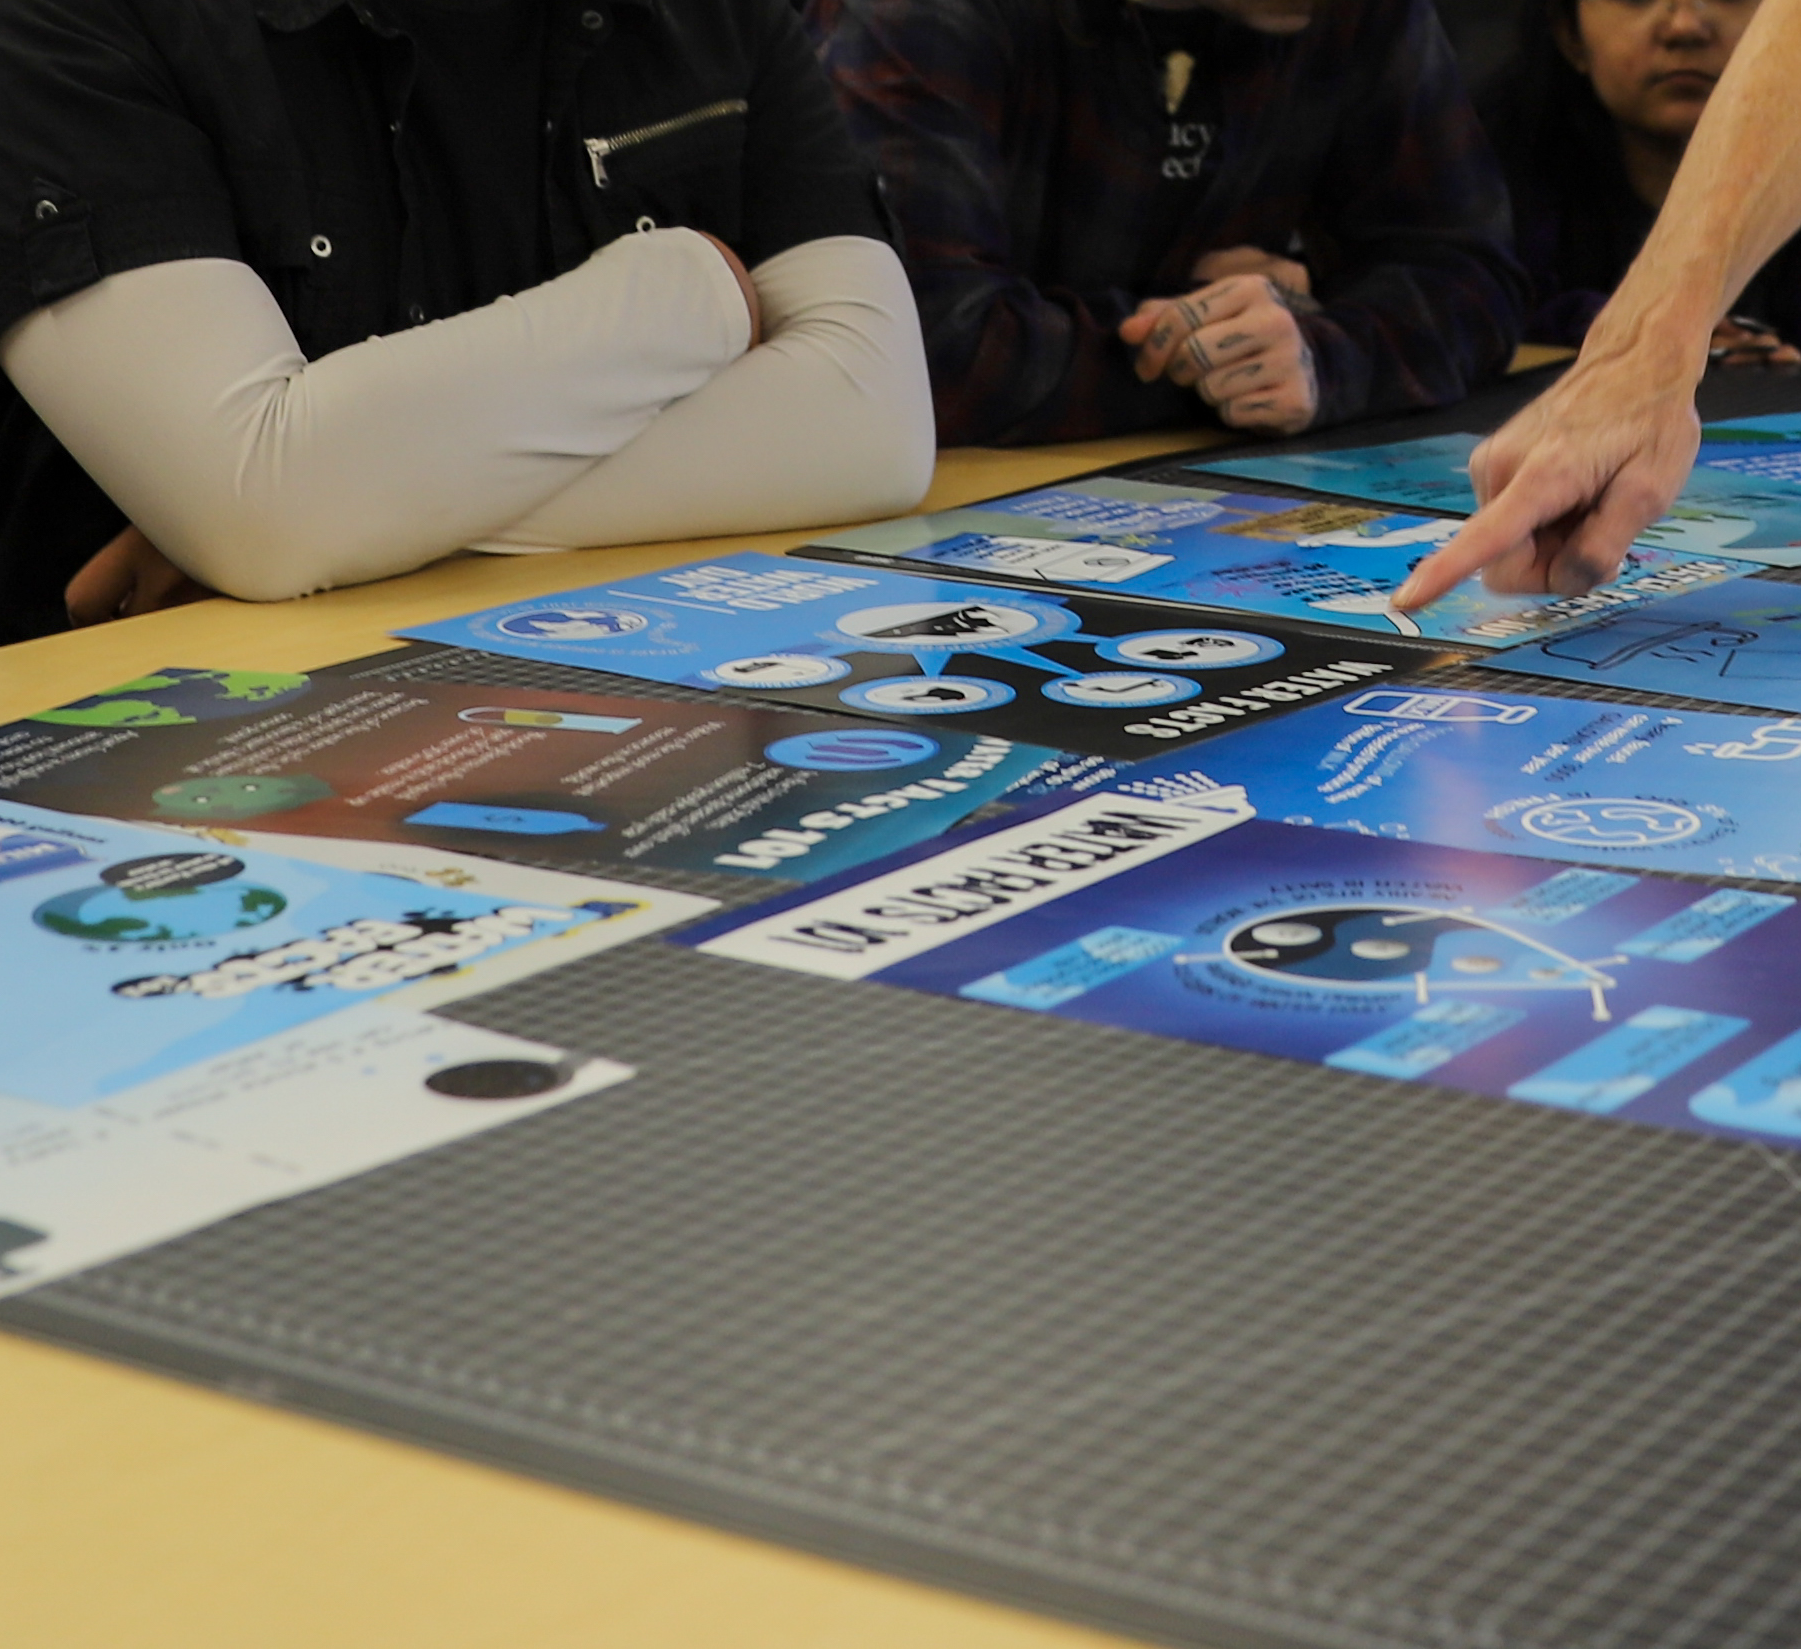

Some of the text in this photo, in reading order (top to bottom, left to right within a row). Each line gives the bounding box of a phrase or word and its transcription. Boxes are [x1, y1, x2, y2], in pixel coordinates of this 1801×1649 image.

[657, 565, 750, 589] DAY
[676, 569, 825, 602] WATER
[726, 575, 880, 612] WORLD
[1123, 660, 1394, 740] WATER FACTS
[799, 778, 967, 832] FACTS
[713, 826, 827, 870] 101
[999, 809, 1202, 876] WATER
[861, 866, 1054, 926] FACTS
